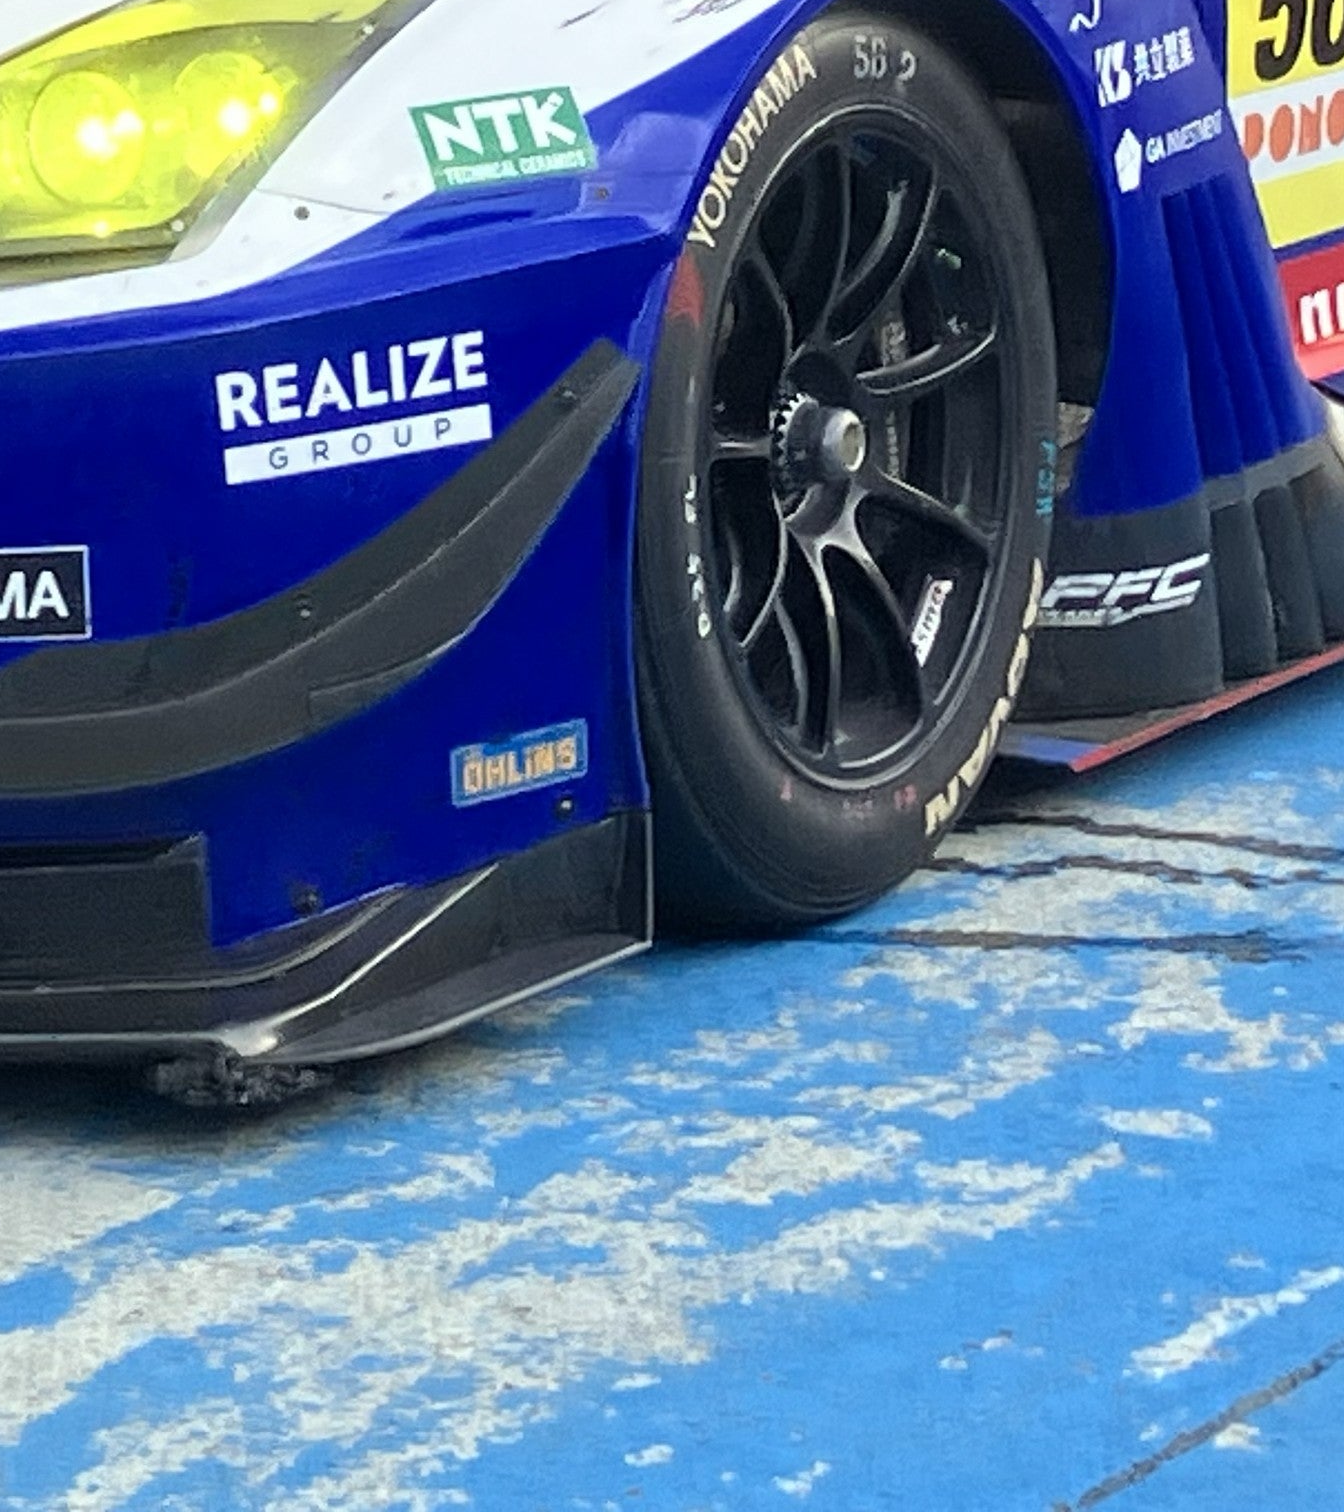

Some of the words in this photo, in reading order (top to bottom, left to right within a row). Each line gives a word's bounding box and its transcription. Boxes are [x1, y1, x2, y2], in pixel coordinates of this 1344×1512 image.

[422, 91, 578, 162] NTK
[686, 43, 817, 248] YOKOHAMA
[214, 330, 489, 432] REALIZE
[268, 417, 452, 470] GROUP
[1040, 553, 1211, 609] PFC
